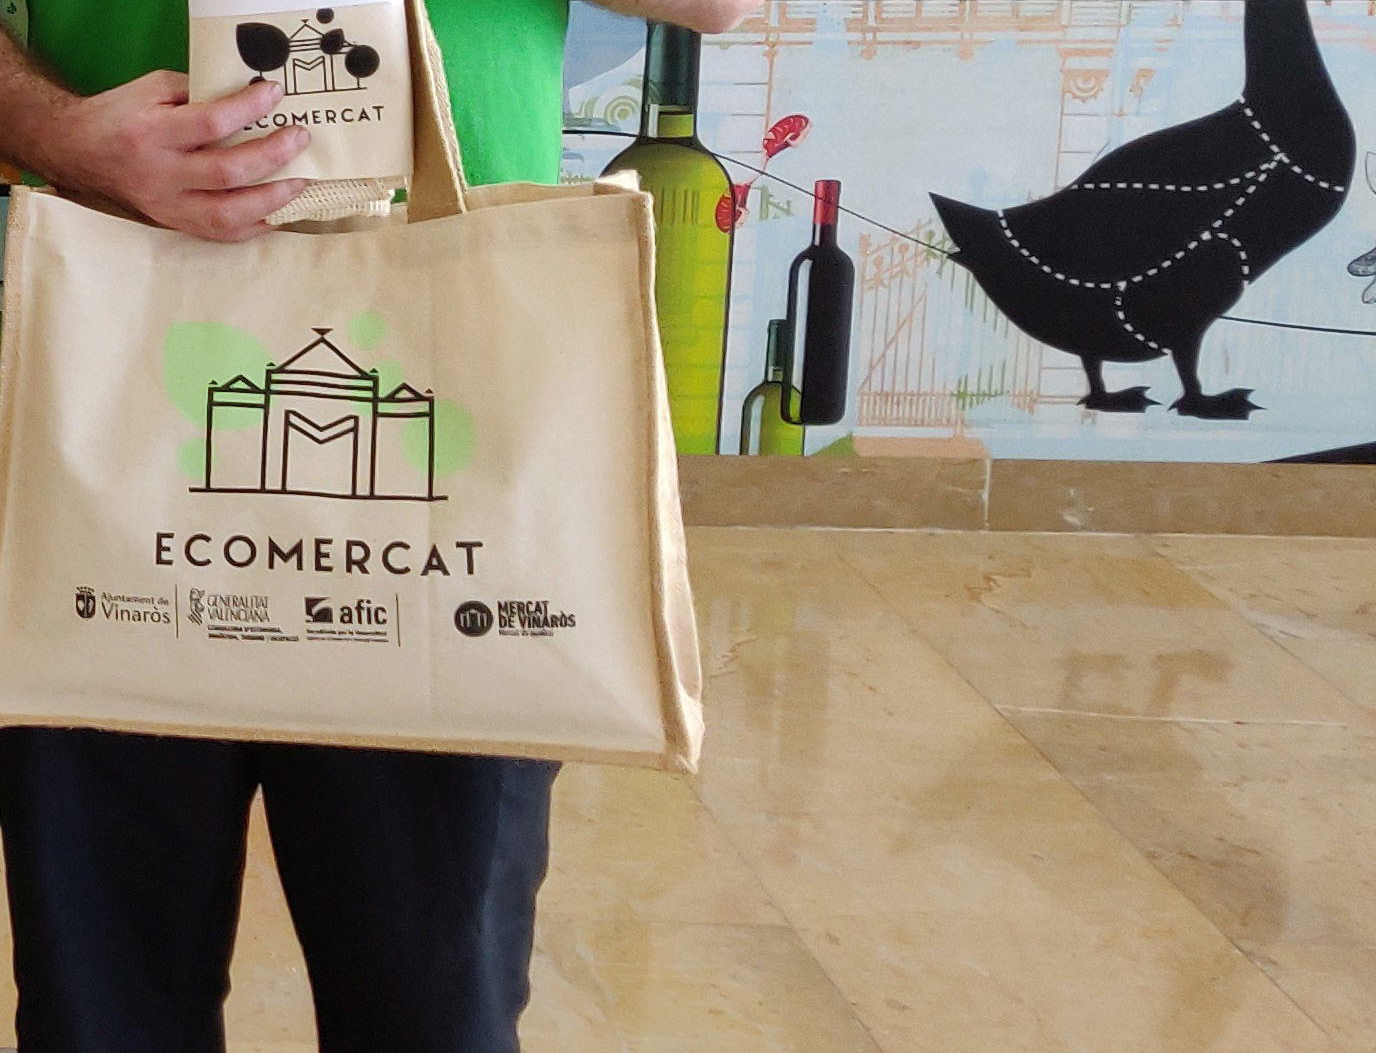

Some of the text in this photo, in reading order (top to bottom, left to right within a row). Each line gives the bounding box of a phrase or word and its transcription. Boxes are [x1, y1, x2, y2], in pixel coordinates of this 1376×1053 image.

[243, 105, 385, 131] COMERCAT
[155, 532, 483, 577] ECOMERCAT
[101, 592, 169, 605] Ajuntament de
[206, 596, 269, 608] GENERALITAT
[497, 600, 550, 615] MERCAT
[101, 601, 170, 624] Vinaròs
[207, 607, 271, 623] VALENCIANA
[339, 598, 388, 625] afic
[498, 611, 576, 629] DE VINARÒS
